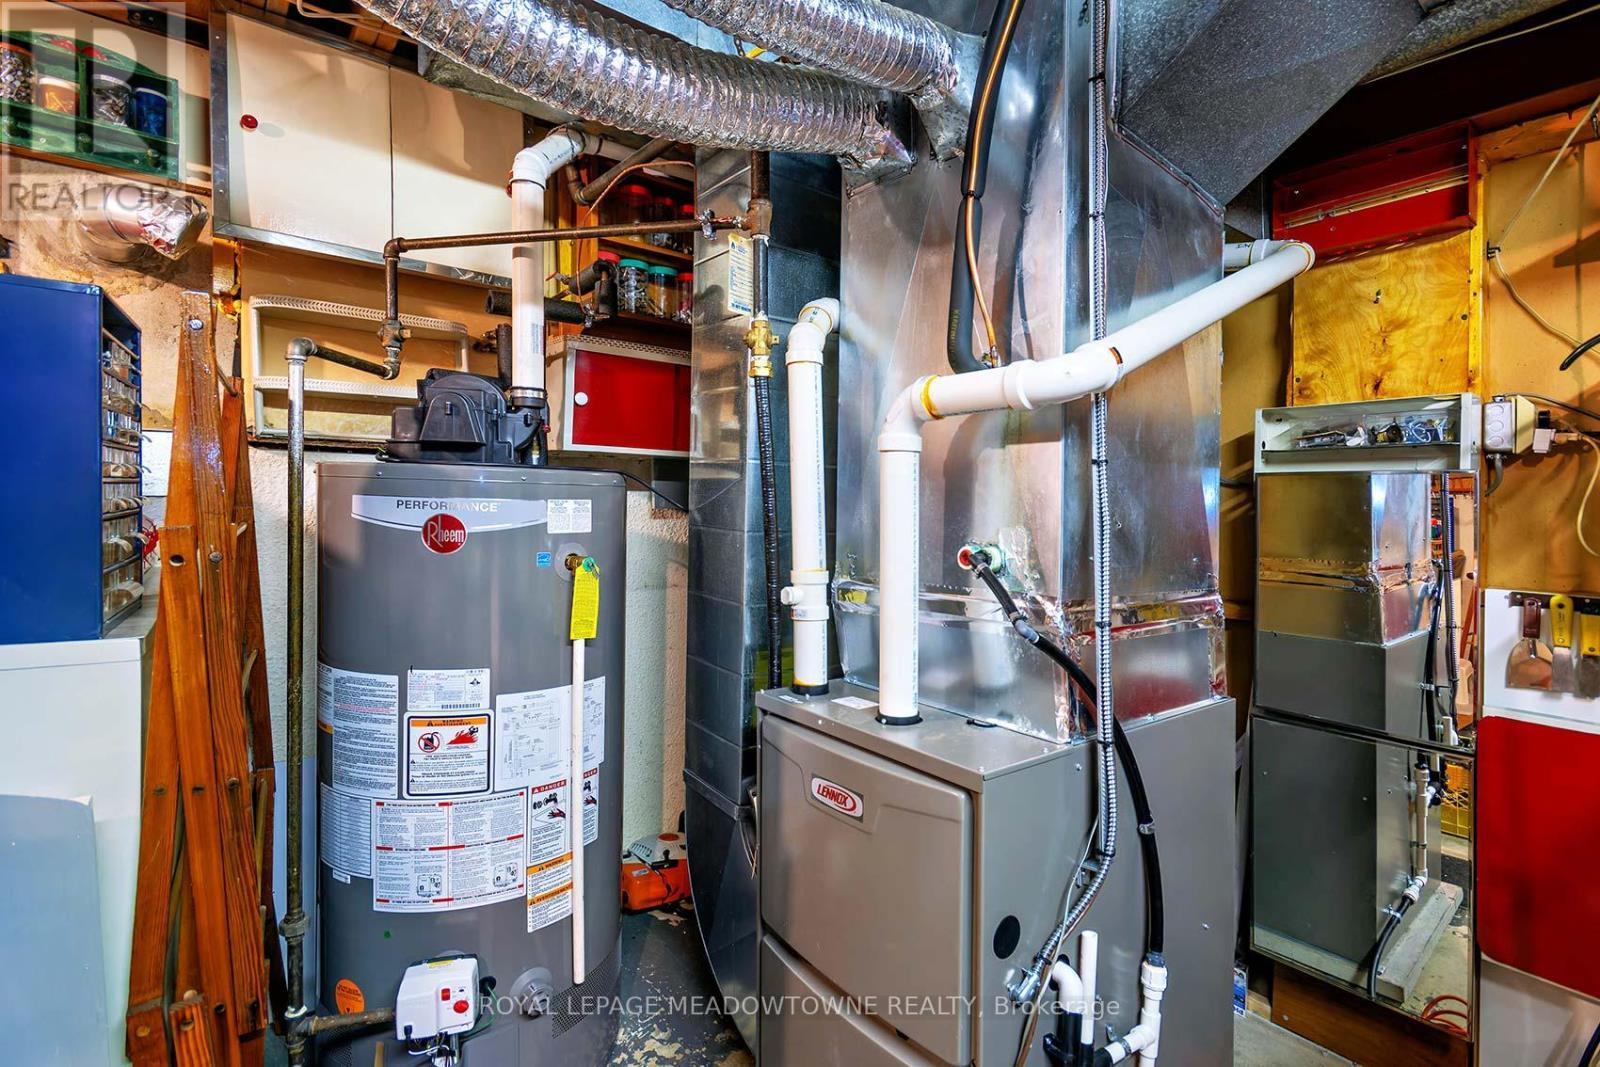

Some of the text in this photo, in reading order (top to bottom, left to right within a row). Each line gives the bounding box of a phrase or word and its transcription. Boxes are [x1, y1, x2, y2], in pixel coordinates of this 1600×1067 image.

[396, 499, 498, 512] PERFORMANCE
[427, 516, 464, 547] Rheem
[816, 784, 849, 807] LENNOX
